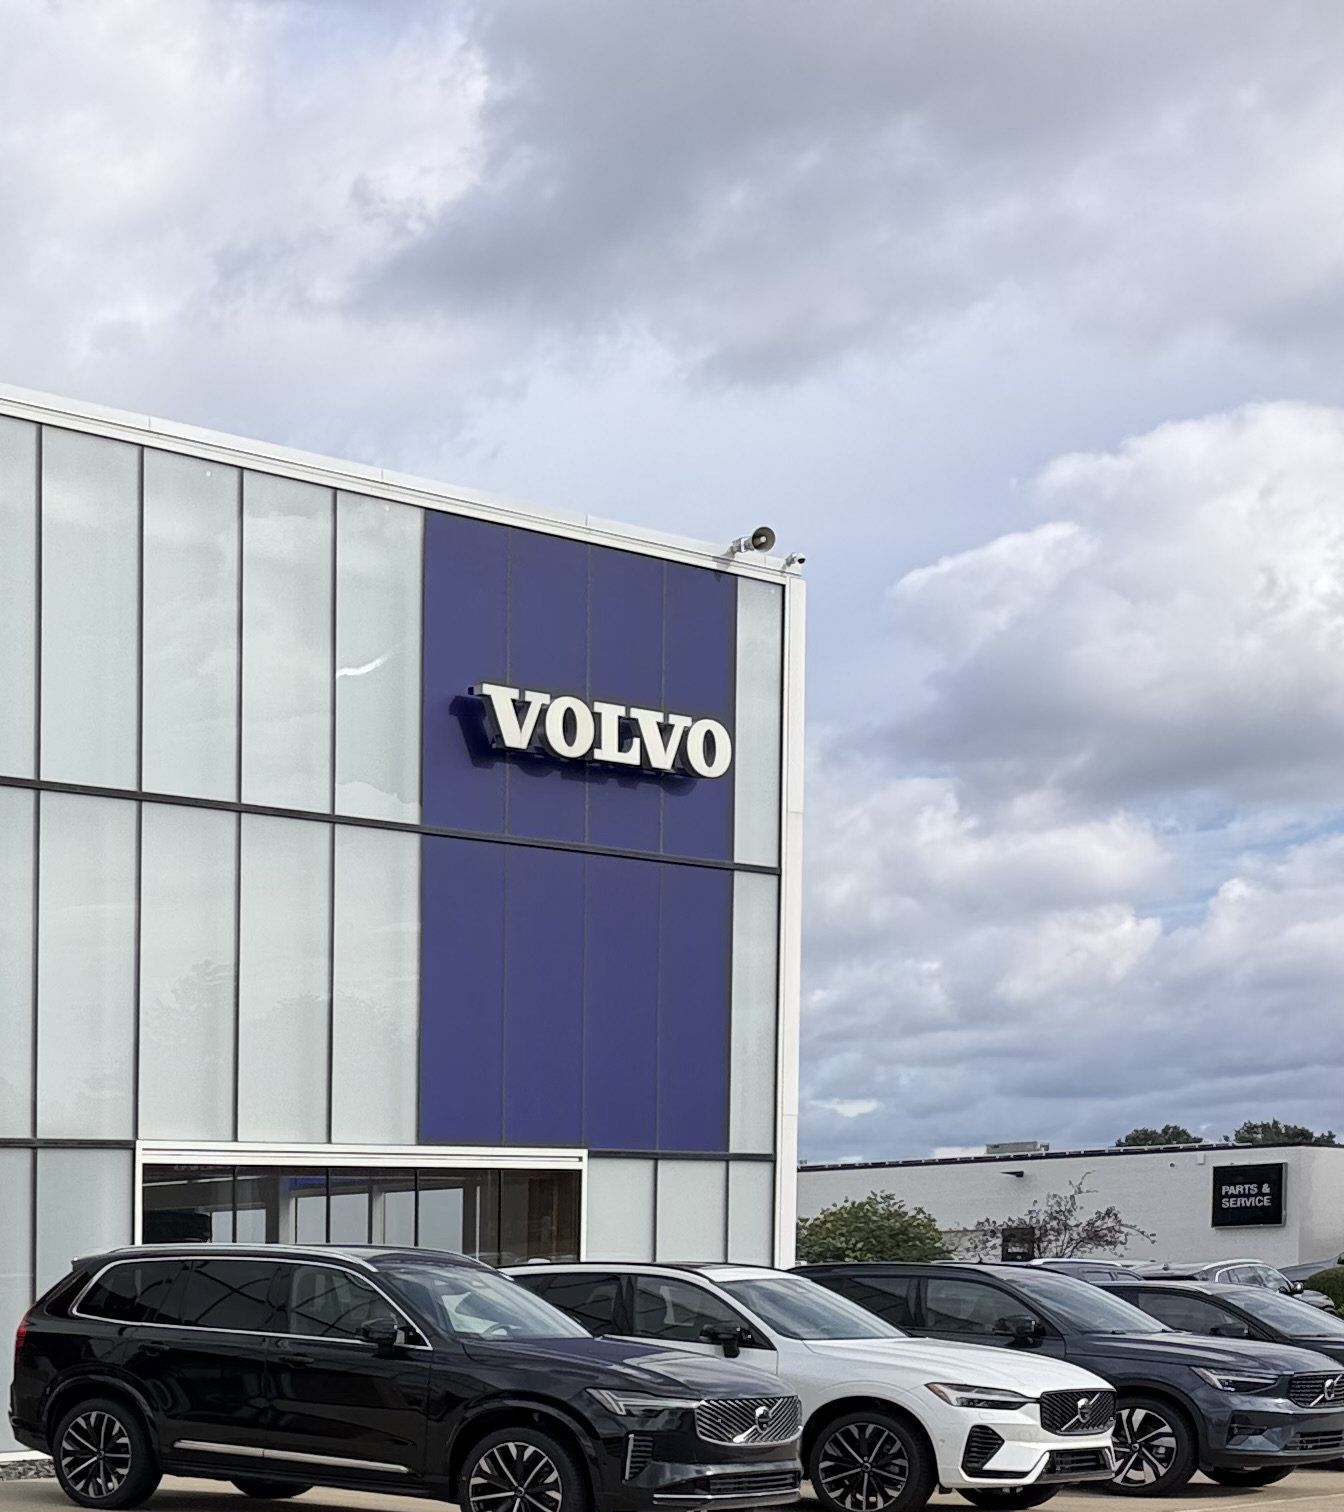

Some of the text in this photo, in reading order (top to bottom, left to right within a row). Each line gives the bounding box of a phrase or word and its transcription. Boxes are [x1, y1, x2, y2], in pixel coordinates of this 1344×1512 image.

[478, 682, 732, 779] VOLVO
[1222, 1183, 1270, 1195] PARTS &
[1222, 1196, 1272, 1208] SERVICE
